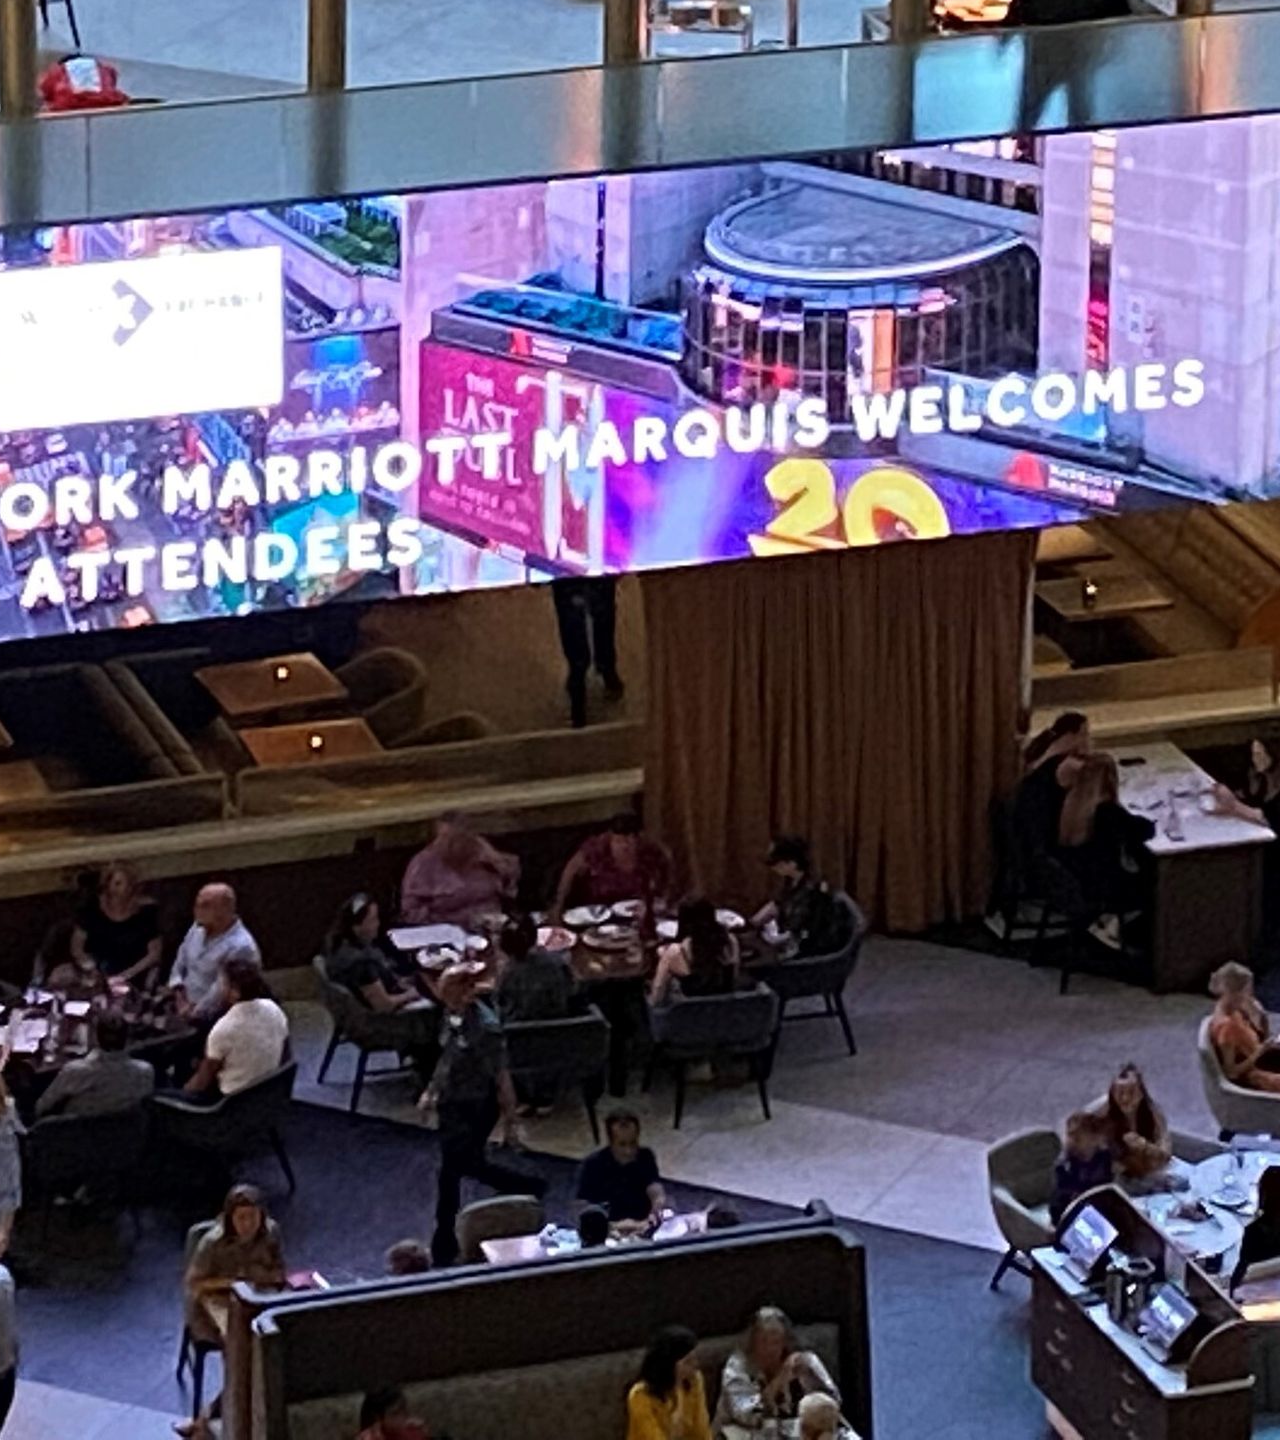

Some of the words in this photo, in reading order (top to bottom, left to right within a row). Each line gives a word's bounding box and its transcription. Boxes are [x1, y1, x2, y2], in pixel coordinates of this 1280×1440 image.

[162, 431, 512, 515] MARRIOTT
[532, 398, 830, 475] MARQUIS
[851, 359, 1206, 441] WELCOMES
[20, 518, 423, 610] ATTENDEES
